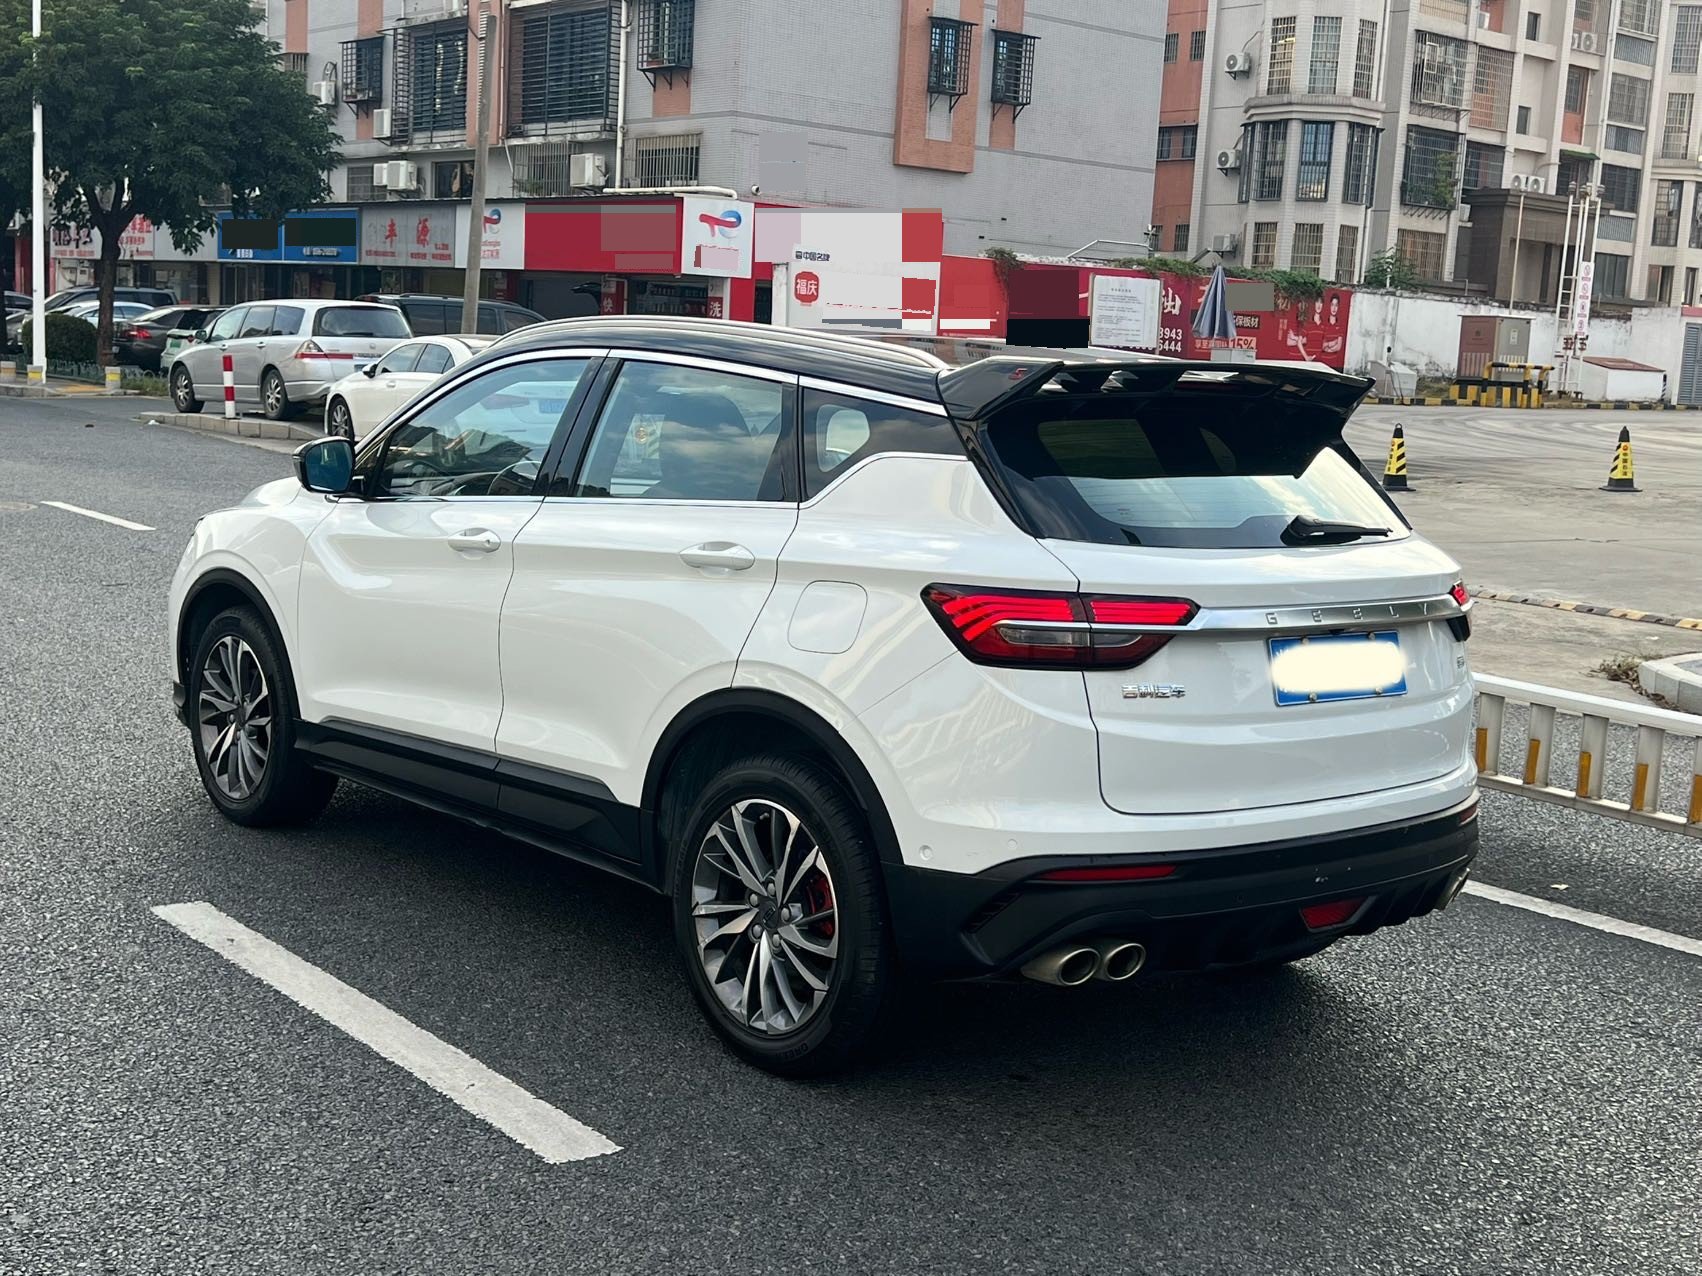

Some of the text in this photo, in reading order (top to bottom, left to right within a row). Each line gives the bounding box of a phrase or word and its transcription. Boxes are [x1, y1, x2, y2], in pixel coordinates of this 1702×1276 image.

[796, 279, 818, 296] 福庆
[709, 301, 722, 318] 洗
[1265, 602, 1428, 625] GEELY
[1122, 684, 1186, 699] 吉利汽车
